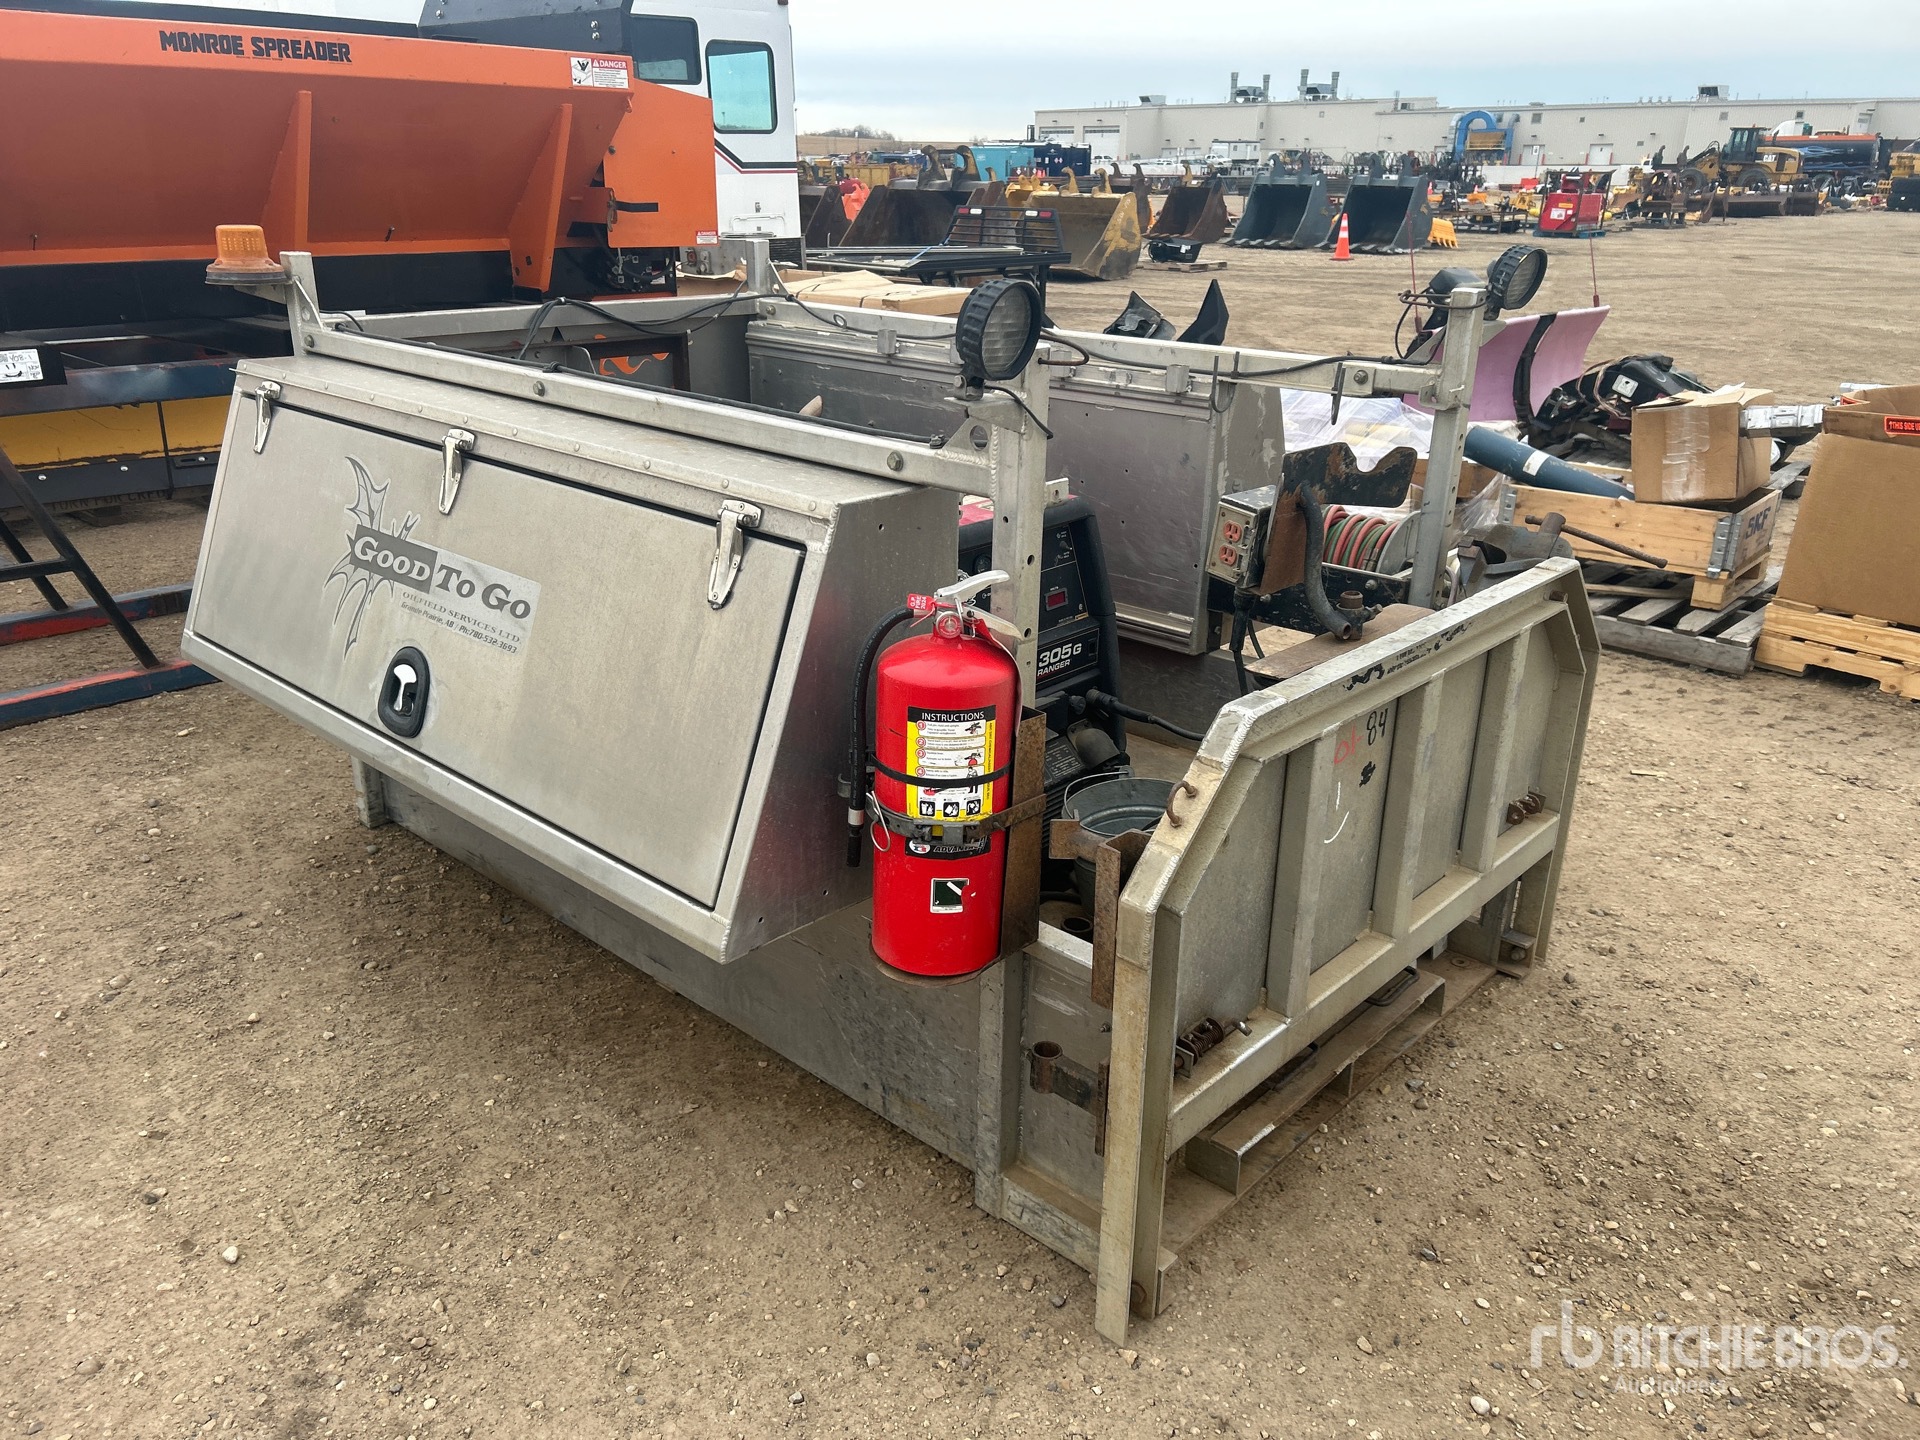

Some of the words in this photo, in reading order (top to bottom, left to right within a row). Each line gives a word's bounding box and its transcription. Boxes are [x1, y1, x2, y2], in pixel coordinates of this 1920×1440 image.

[159, 30, 245, 56] MONROE
[250, 36, 352, 63] SPREADER
[599, 60, 627, 69] DANGER
[1763, 154, 1777, 163] CAT
[1892, 421, 1904, 430] THIS
[1904, 421, 1915, 431] SIDE
[1744, 506, 1772, 540] SKF
[400, 601, 423, 615] Grande
[445, 619, 455, 628] AB
[402, 591, 448, 614] OILFIELD
[447, 610, 498, 634] SERVICES
[498, 629, 523, 645] LTD.
[1037, 659, 1072, 677] RANGER
[921, 711, 985, 722] INSTRUCTIONS
[1366, 707, 1390, 747] 84
